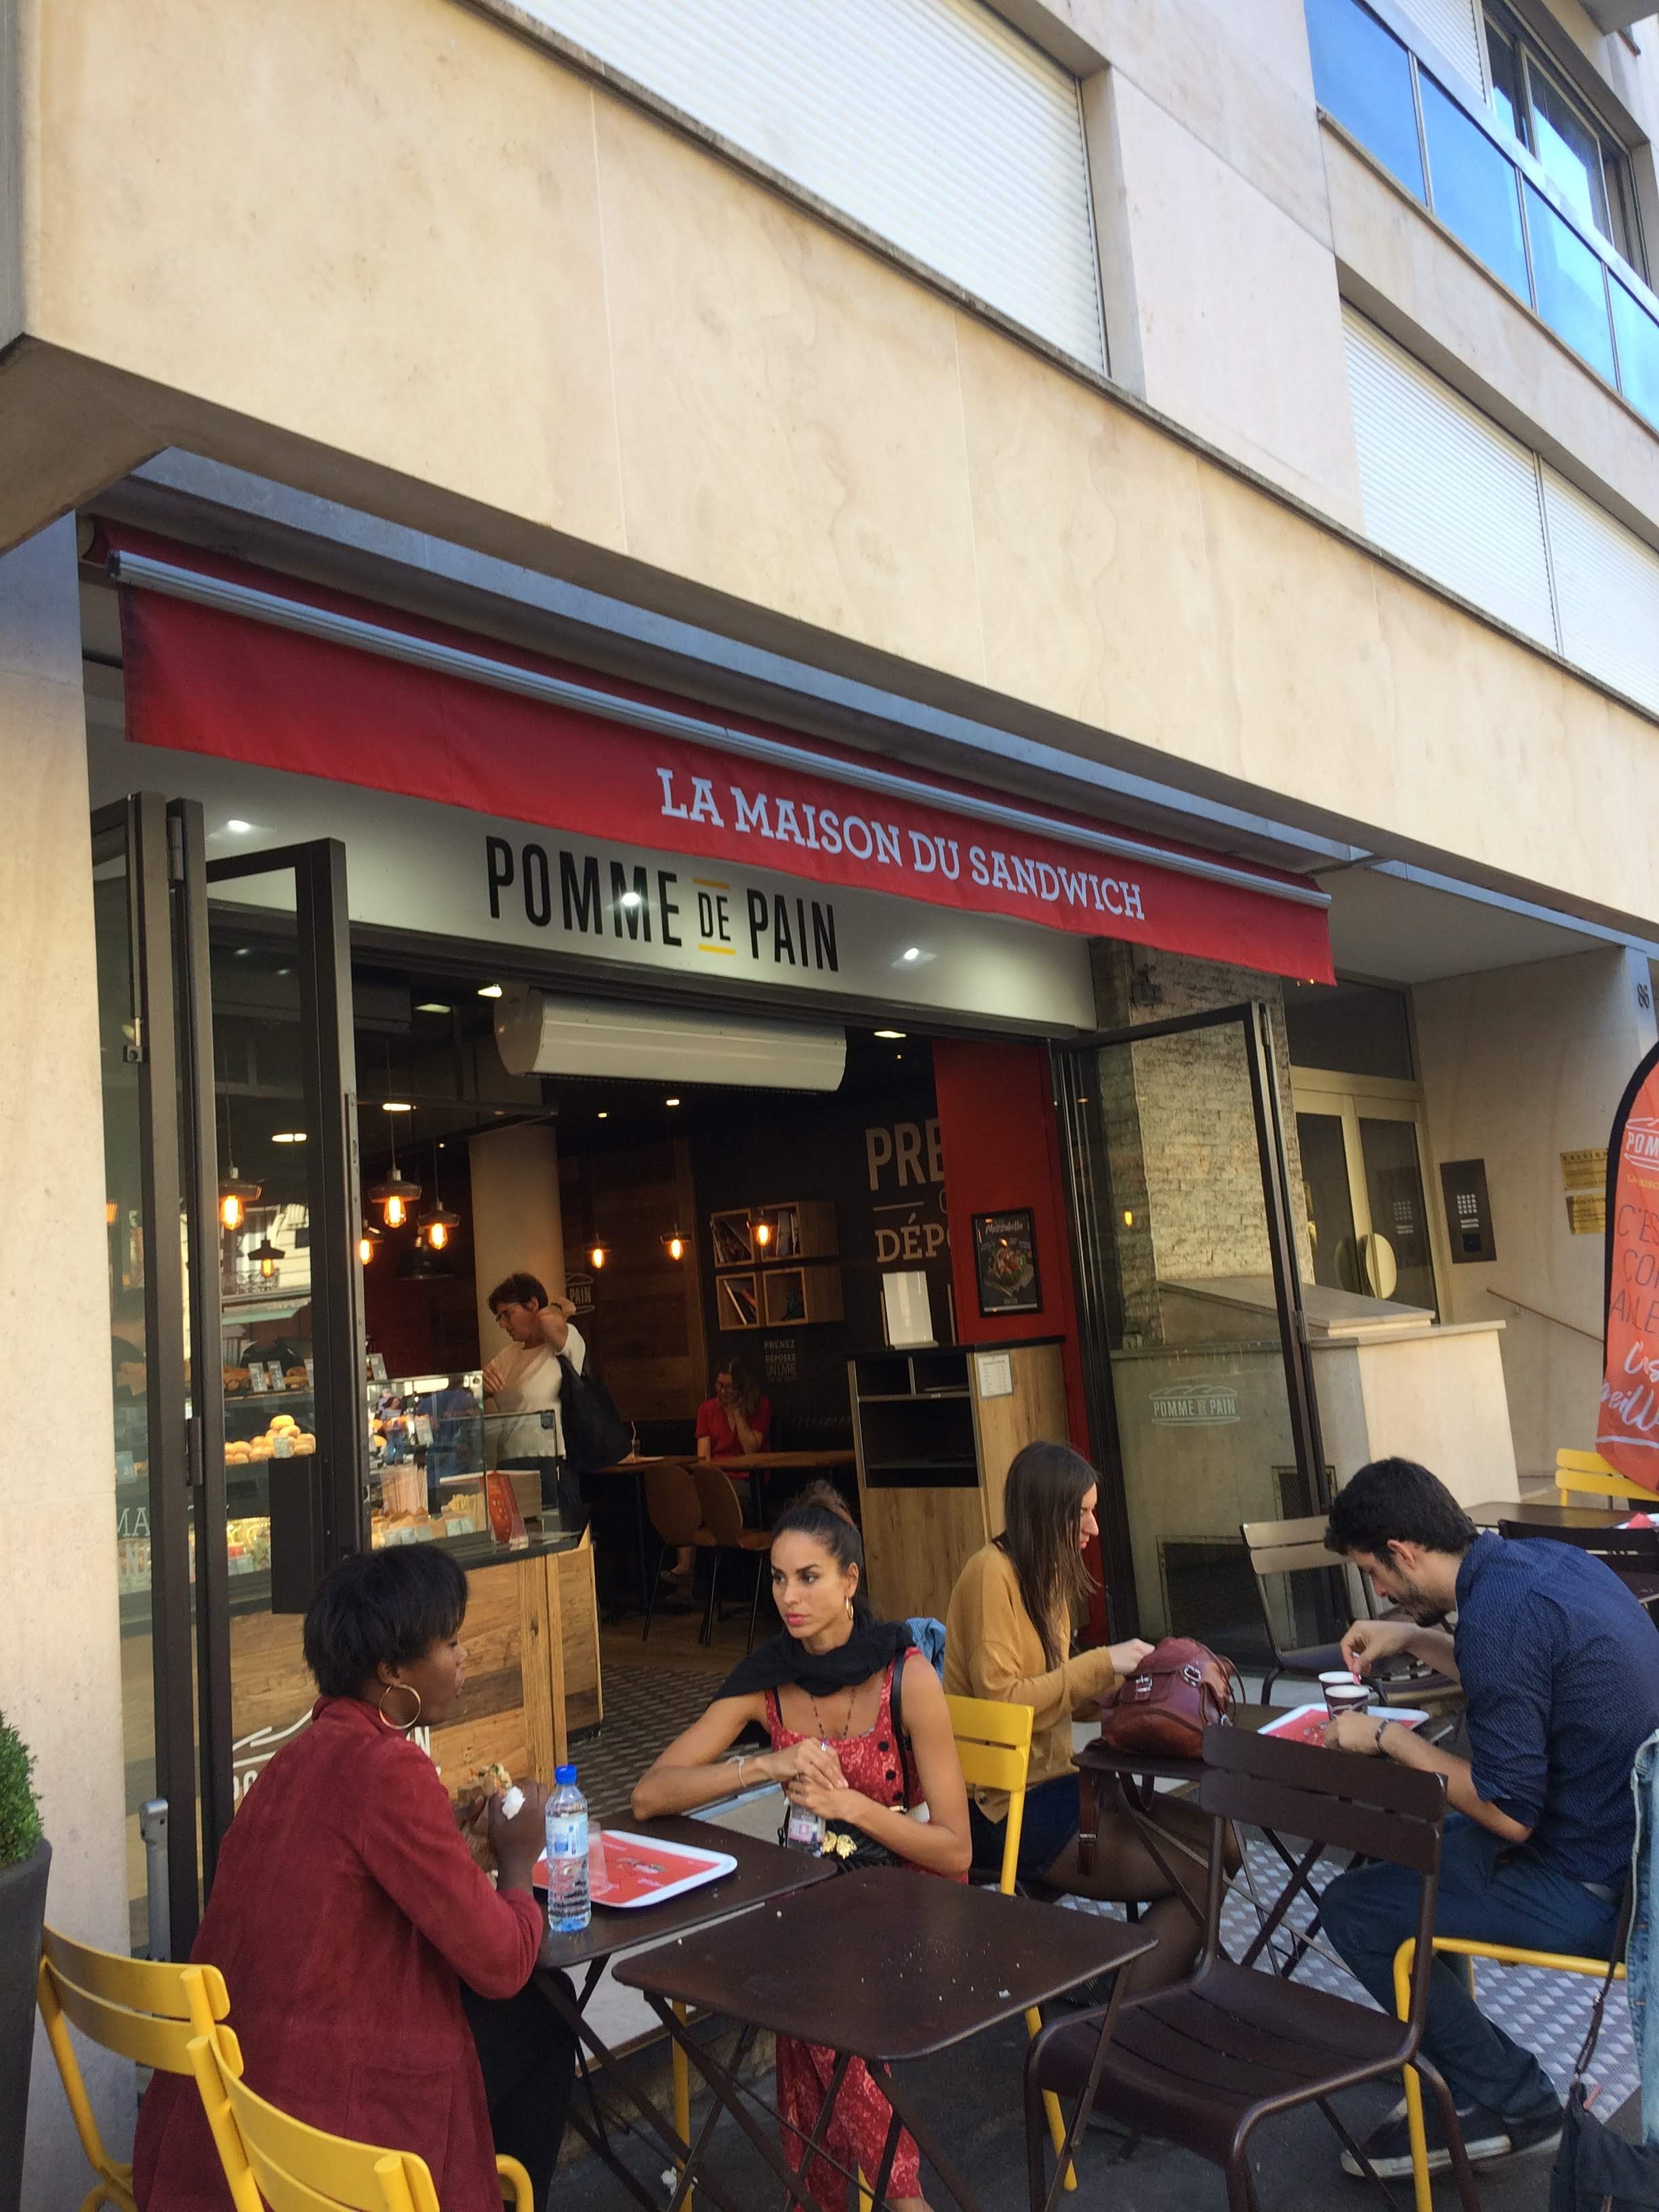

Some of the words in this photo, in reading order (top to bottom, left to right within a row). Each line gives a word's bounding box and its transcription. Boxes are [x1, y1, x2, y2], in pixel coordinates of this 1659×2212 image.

[657, 767, 724, 827] LA
[730, 785, 903, 867] MAISON
[908, 830, 960, 880] DU
[969, 845, 1145, 921] SANDWICH
[486, 836, 682, 947] POMME
[698, 892, 731, 942] DE
[747, 888, 838, 972] PAIN
[1637, 983, 1650, 1009] 86
[874, 1212, 951, 1263] DÉP
[1624, 1248, 1659, 1288] CO
[1153, 1400, 1195, 1418] POMME
[1209, 1397, 1237, 1416] PAIN
